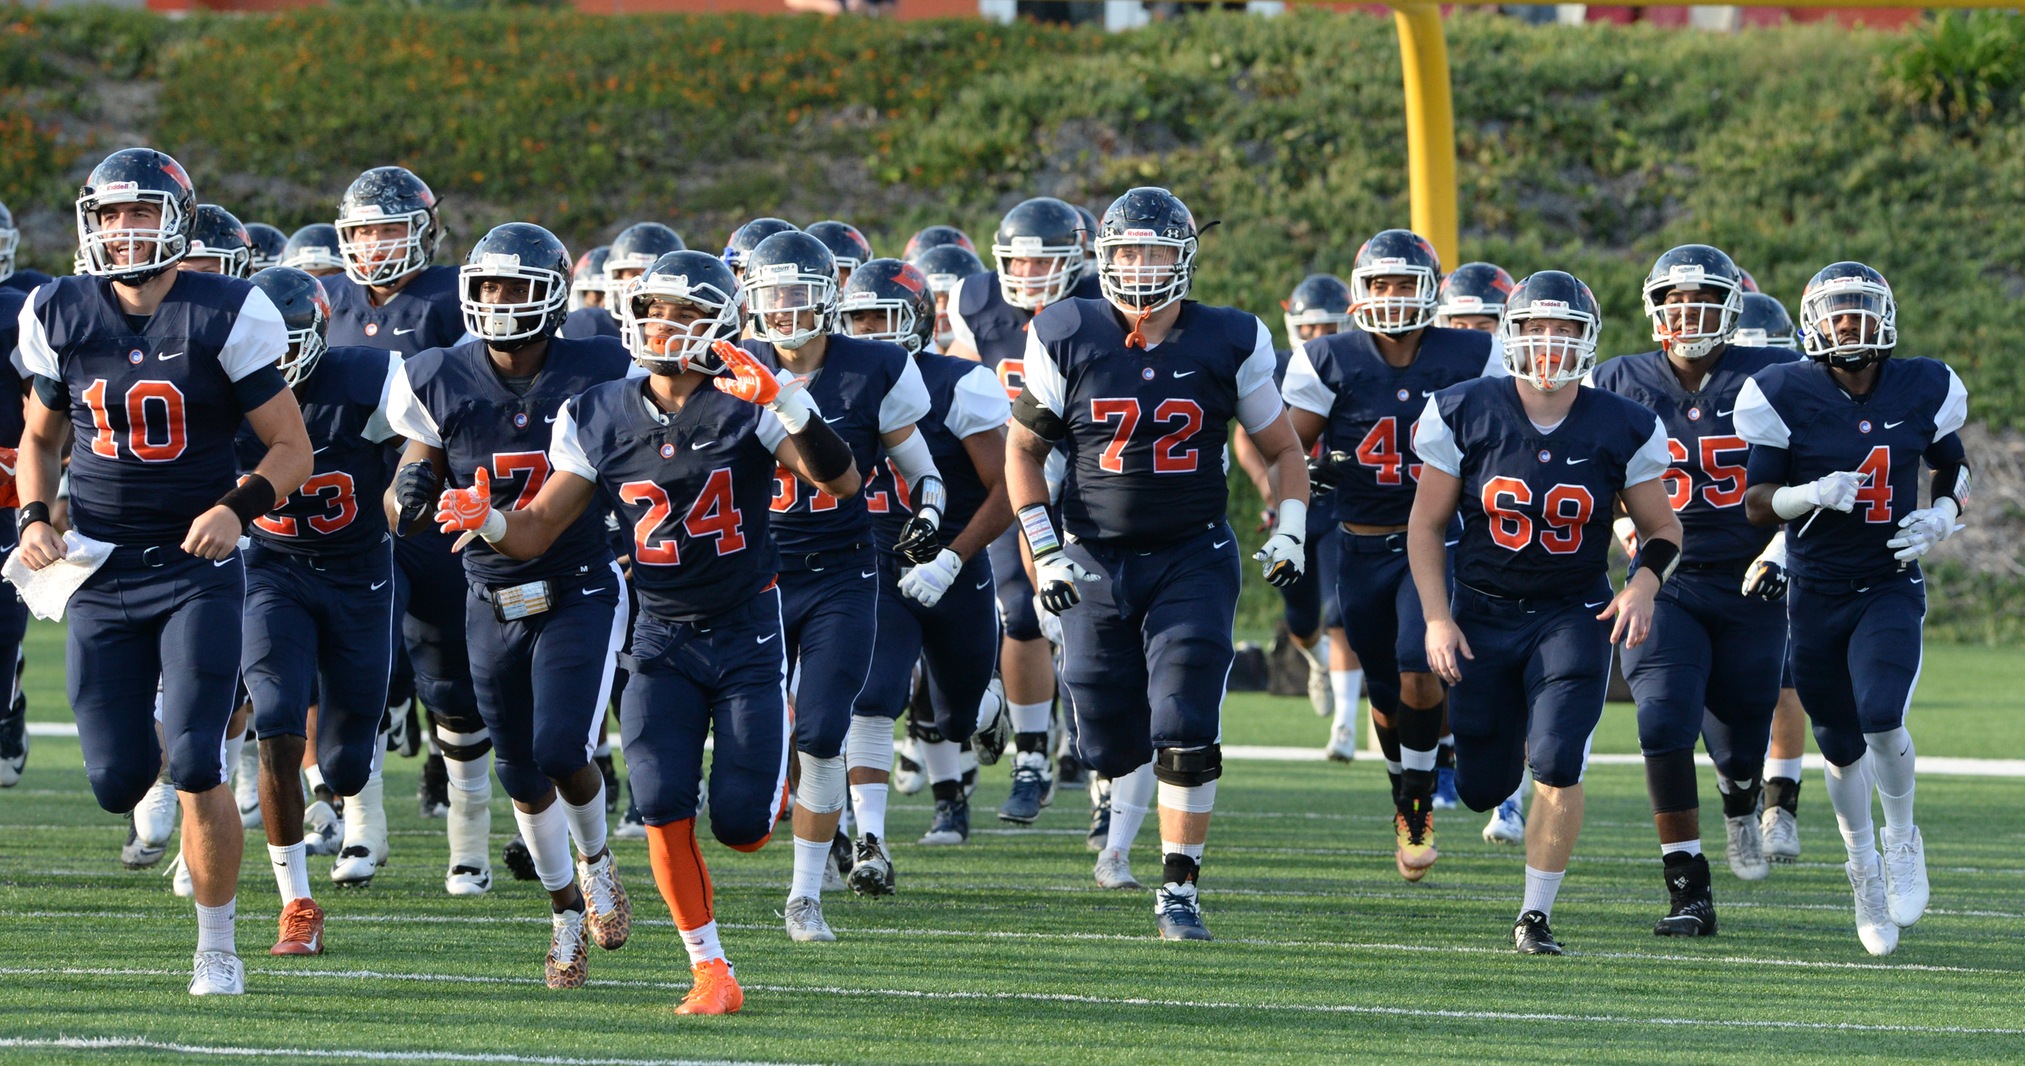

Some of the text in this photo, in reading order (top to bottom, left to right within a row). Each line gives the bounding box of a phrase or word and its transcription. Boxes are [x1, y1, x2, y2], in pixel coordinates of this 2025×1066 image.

[82, 378, 188, 463] 10
[1090, 397, 1205, 474] 72
[1355, 416, 1424, 486] 4
[492, 449, 552, 512] 7
[1661, 434, 1749, 513] 65
[1854, 445, 1893, 524] 4
[618, 466, 747, 566] 24
[1481, 475, 1595, 555] 69
